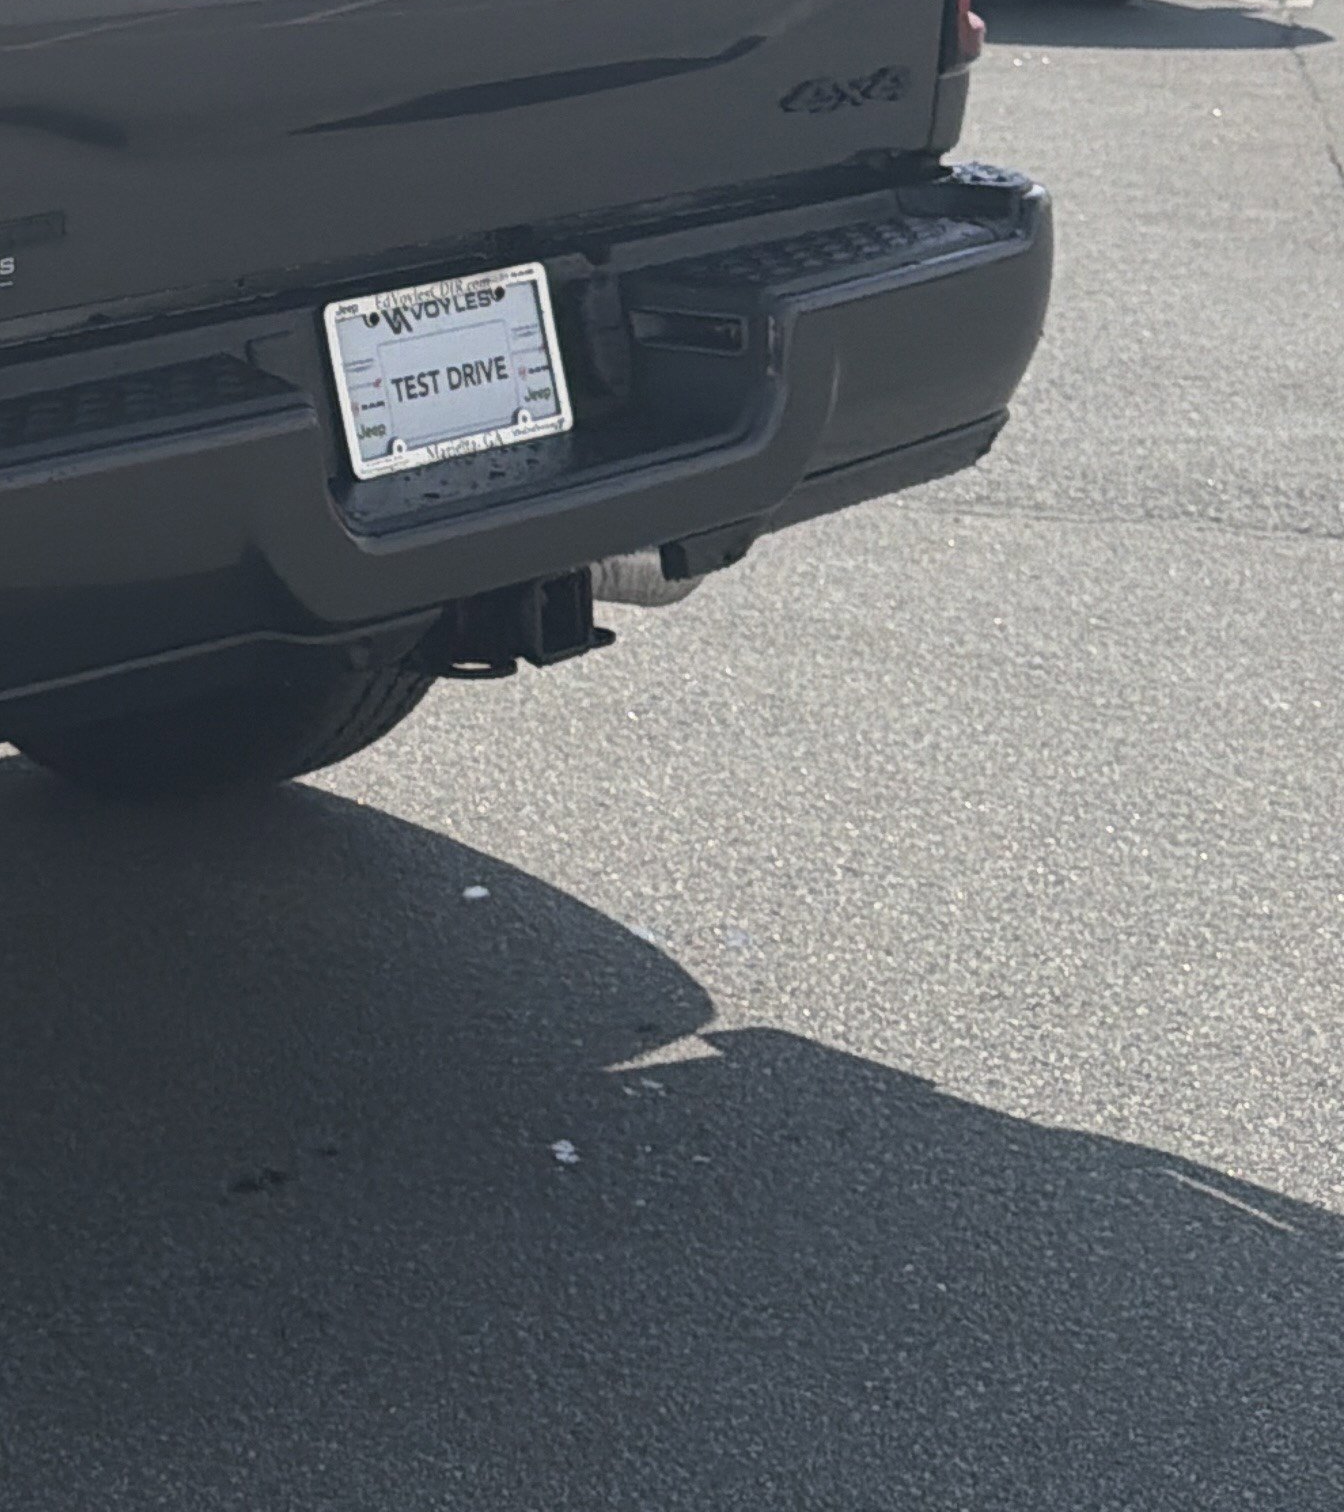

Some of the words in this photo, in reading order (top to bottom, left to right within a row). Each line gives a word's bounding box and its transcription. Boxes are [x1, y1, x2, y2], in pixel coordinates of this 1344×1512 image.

[410, 287, 494, 321] VOYLES
[390, 368, 440, 403] TEST
[446, 354, 510, 391] DRIVE
